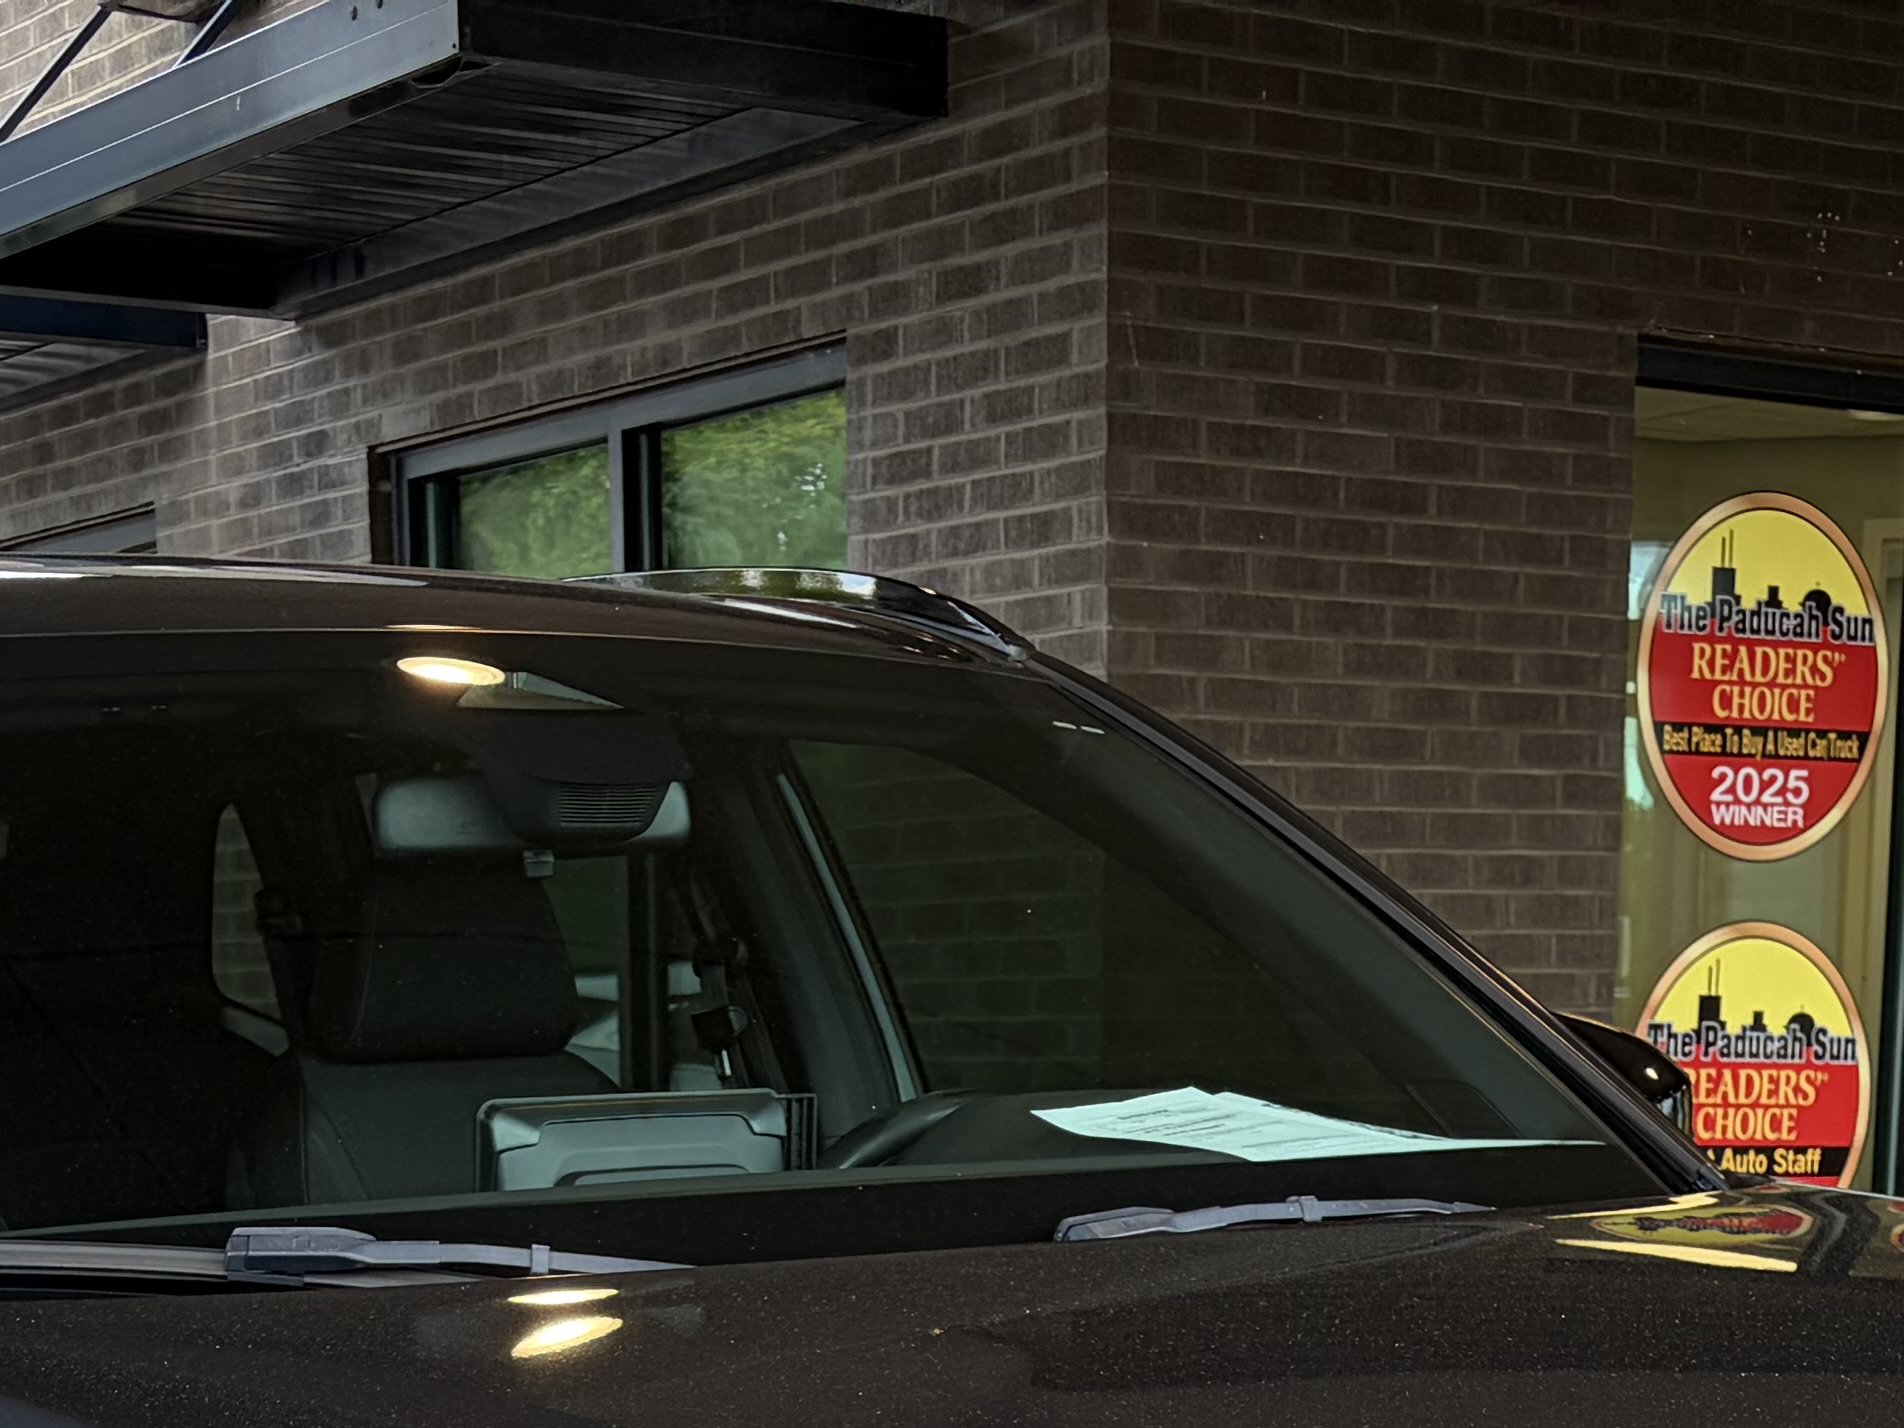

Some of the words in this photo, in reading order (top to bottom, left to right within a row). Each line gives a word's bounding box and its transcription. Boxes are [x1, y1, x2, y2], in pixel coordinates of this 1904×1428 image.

[1660, 592, 1709, 634] The
[1716, 596, 1822, 641] Paducah
[1828, 606, 1875, 645] Sun
[1712, 685, 1815, 722] CHOICE
[1663, 725, 1688, 751] Best
[1692, 726, 1722, 753] Place
[1742, 729, 1764, 760] Buy
[1766, 730, 1775, 755] A
[1777, 731, 1805, 757] Used
[1709, 766, 1810, 805] 2025
[1711, 804, 1804, 828] WINNER
[1648, 1022, 1693, 1060] The
[1700, 1022, 1806, 1063] Paducah
[1812, 1028, 1856, 1064] Sun
[1696, 1107, 1798, 1141] CHOICE
[1720, 1148, 1768, 1173] Auto
[1773, 1148, 1822, 1174] Staff
